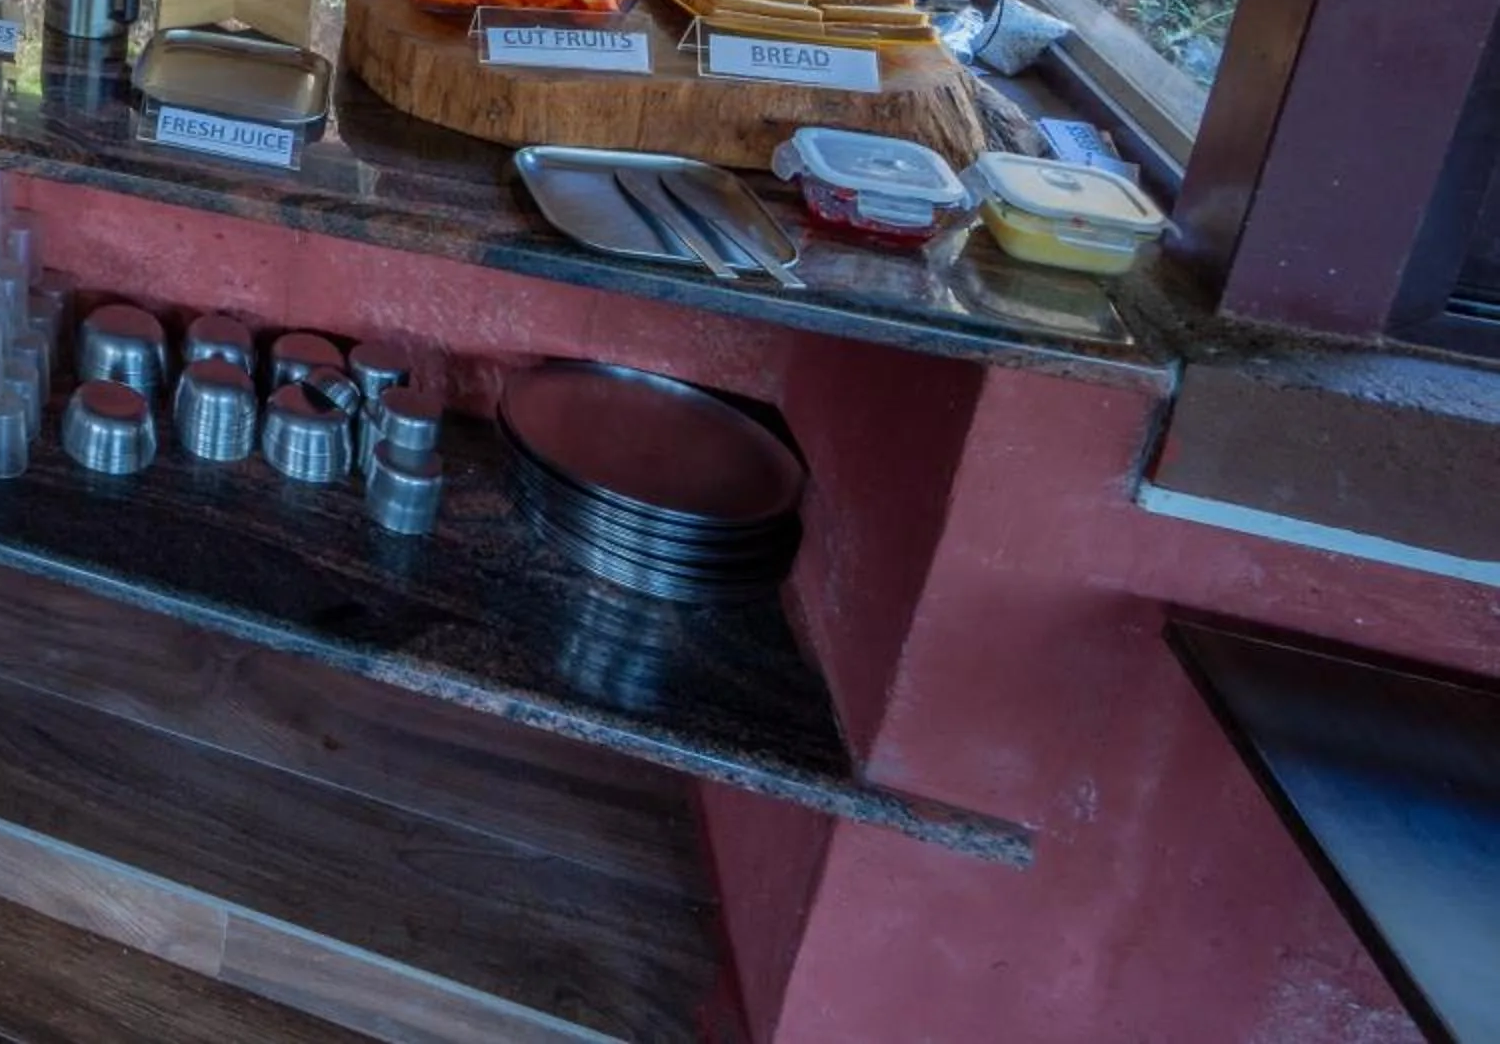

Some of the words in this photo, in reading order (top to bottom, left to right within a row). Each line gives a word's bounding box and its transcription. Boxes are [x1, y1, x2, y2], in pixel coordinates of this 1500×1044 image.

[504, 29, 547, 45] CUT
[554, 31, 633, 49] FRUITS
[751, 45, 831, 67] BREAD
[162, 114, 225, 139] FRESH
[230, 126, 289, 150] JUICE
